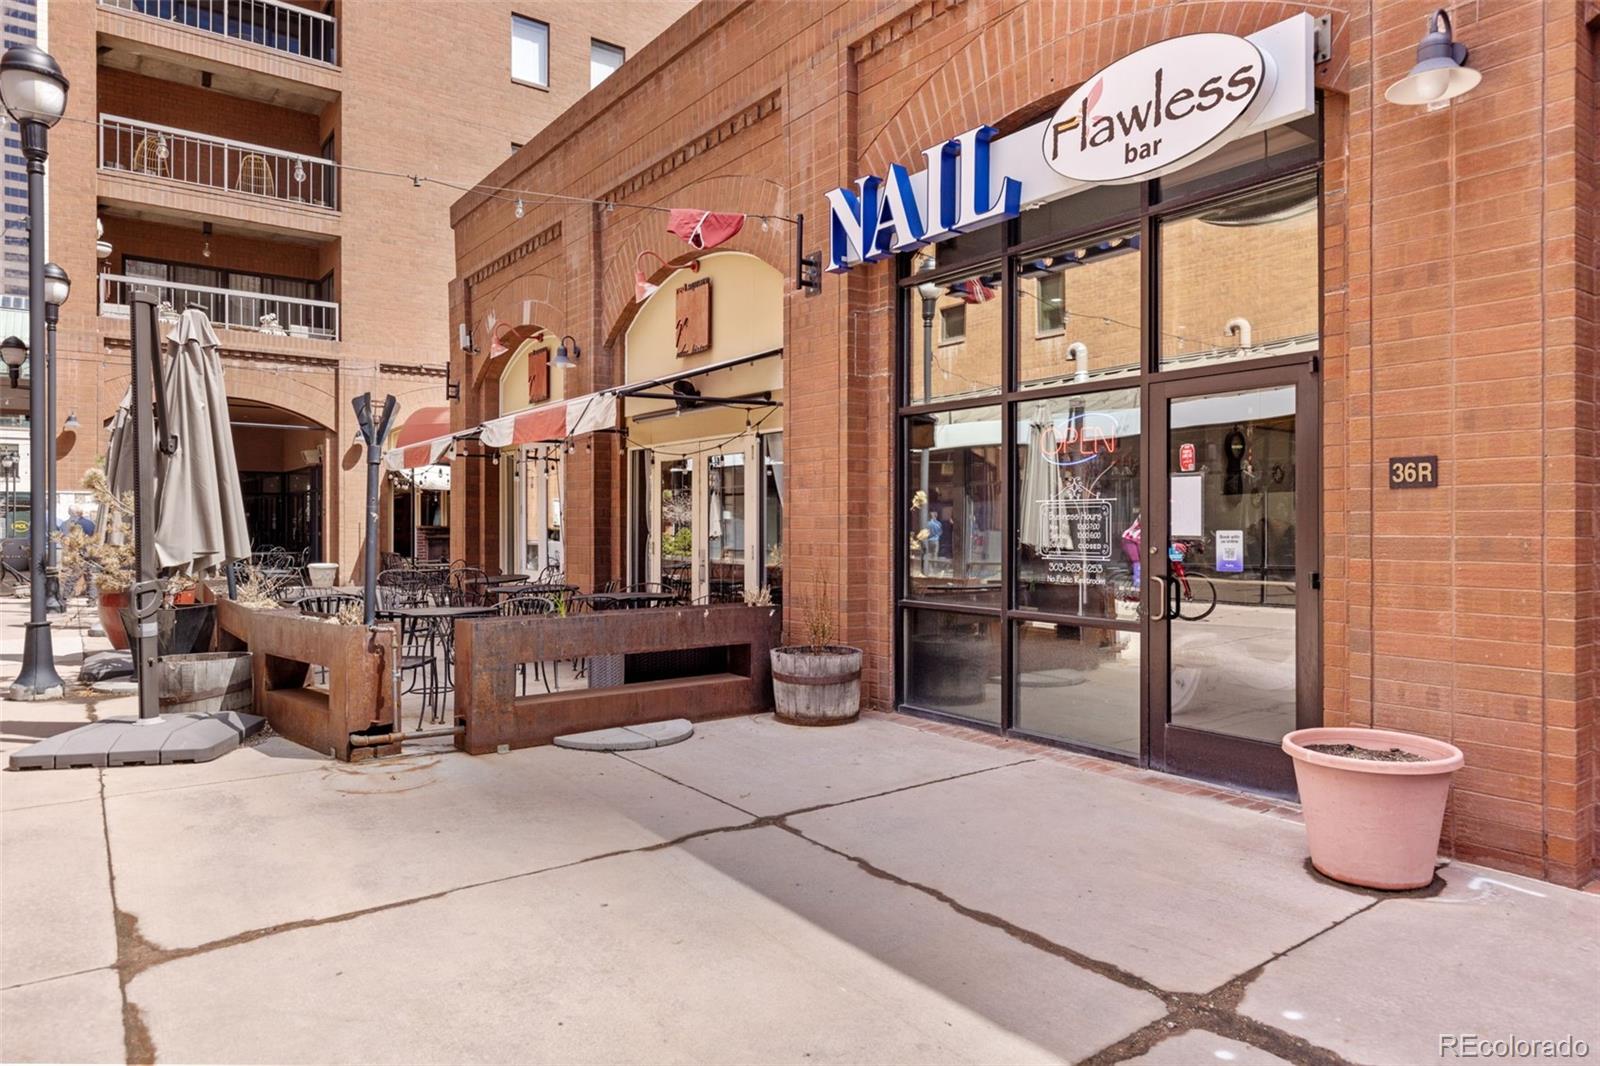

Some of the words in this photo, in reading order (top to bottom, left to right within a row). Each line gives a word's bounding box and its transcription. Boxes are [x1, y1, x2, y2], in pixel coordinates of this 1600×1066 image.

[1051, 64, 1257, 161] Flawless
[1124, 136, 1163, 165] bar
[825, 124, 1022, 274] NAIL
[1041, 426, 1115, 455] OPEN
[1392, 462, 1433, 483] 36R
[1080, 511, 1103, 521] Hours
